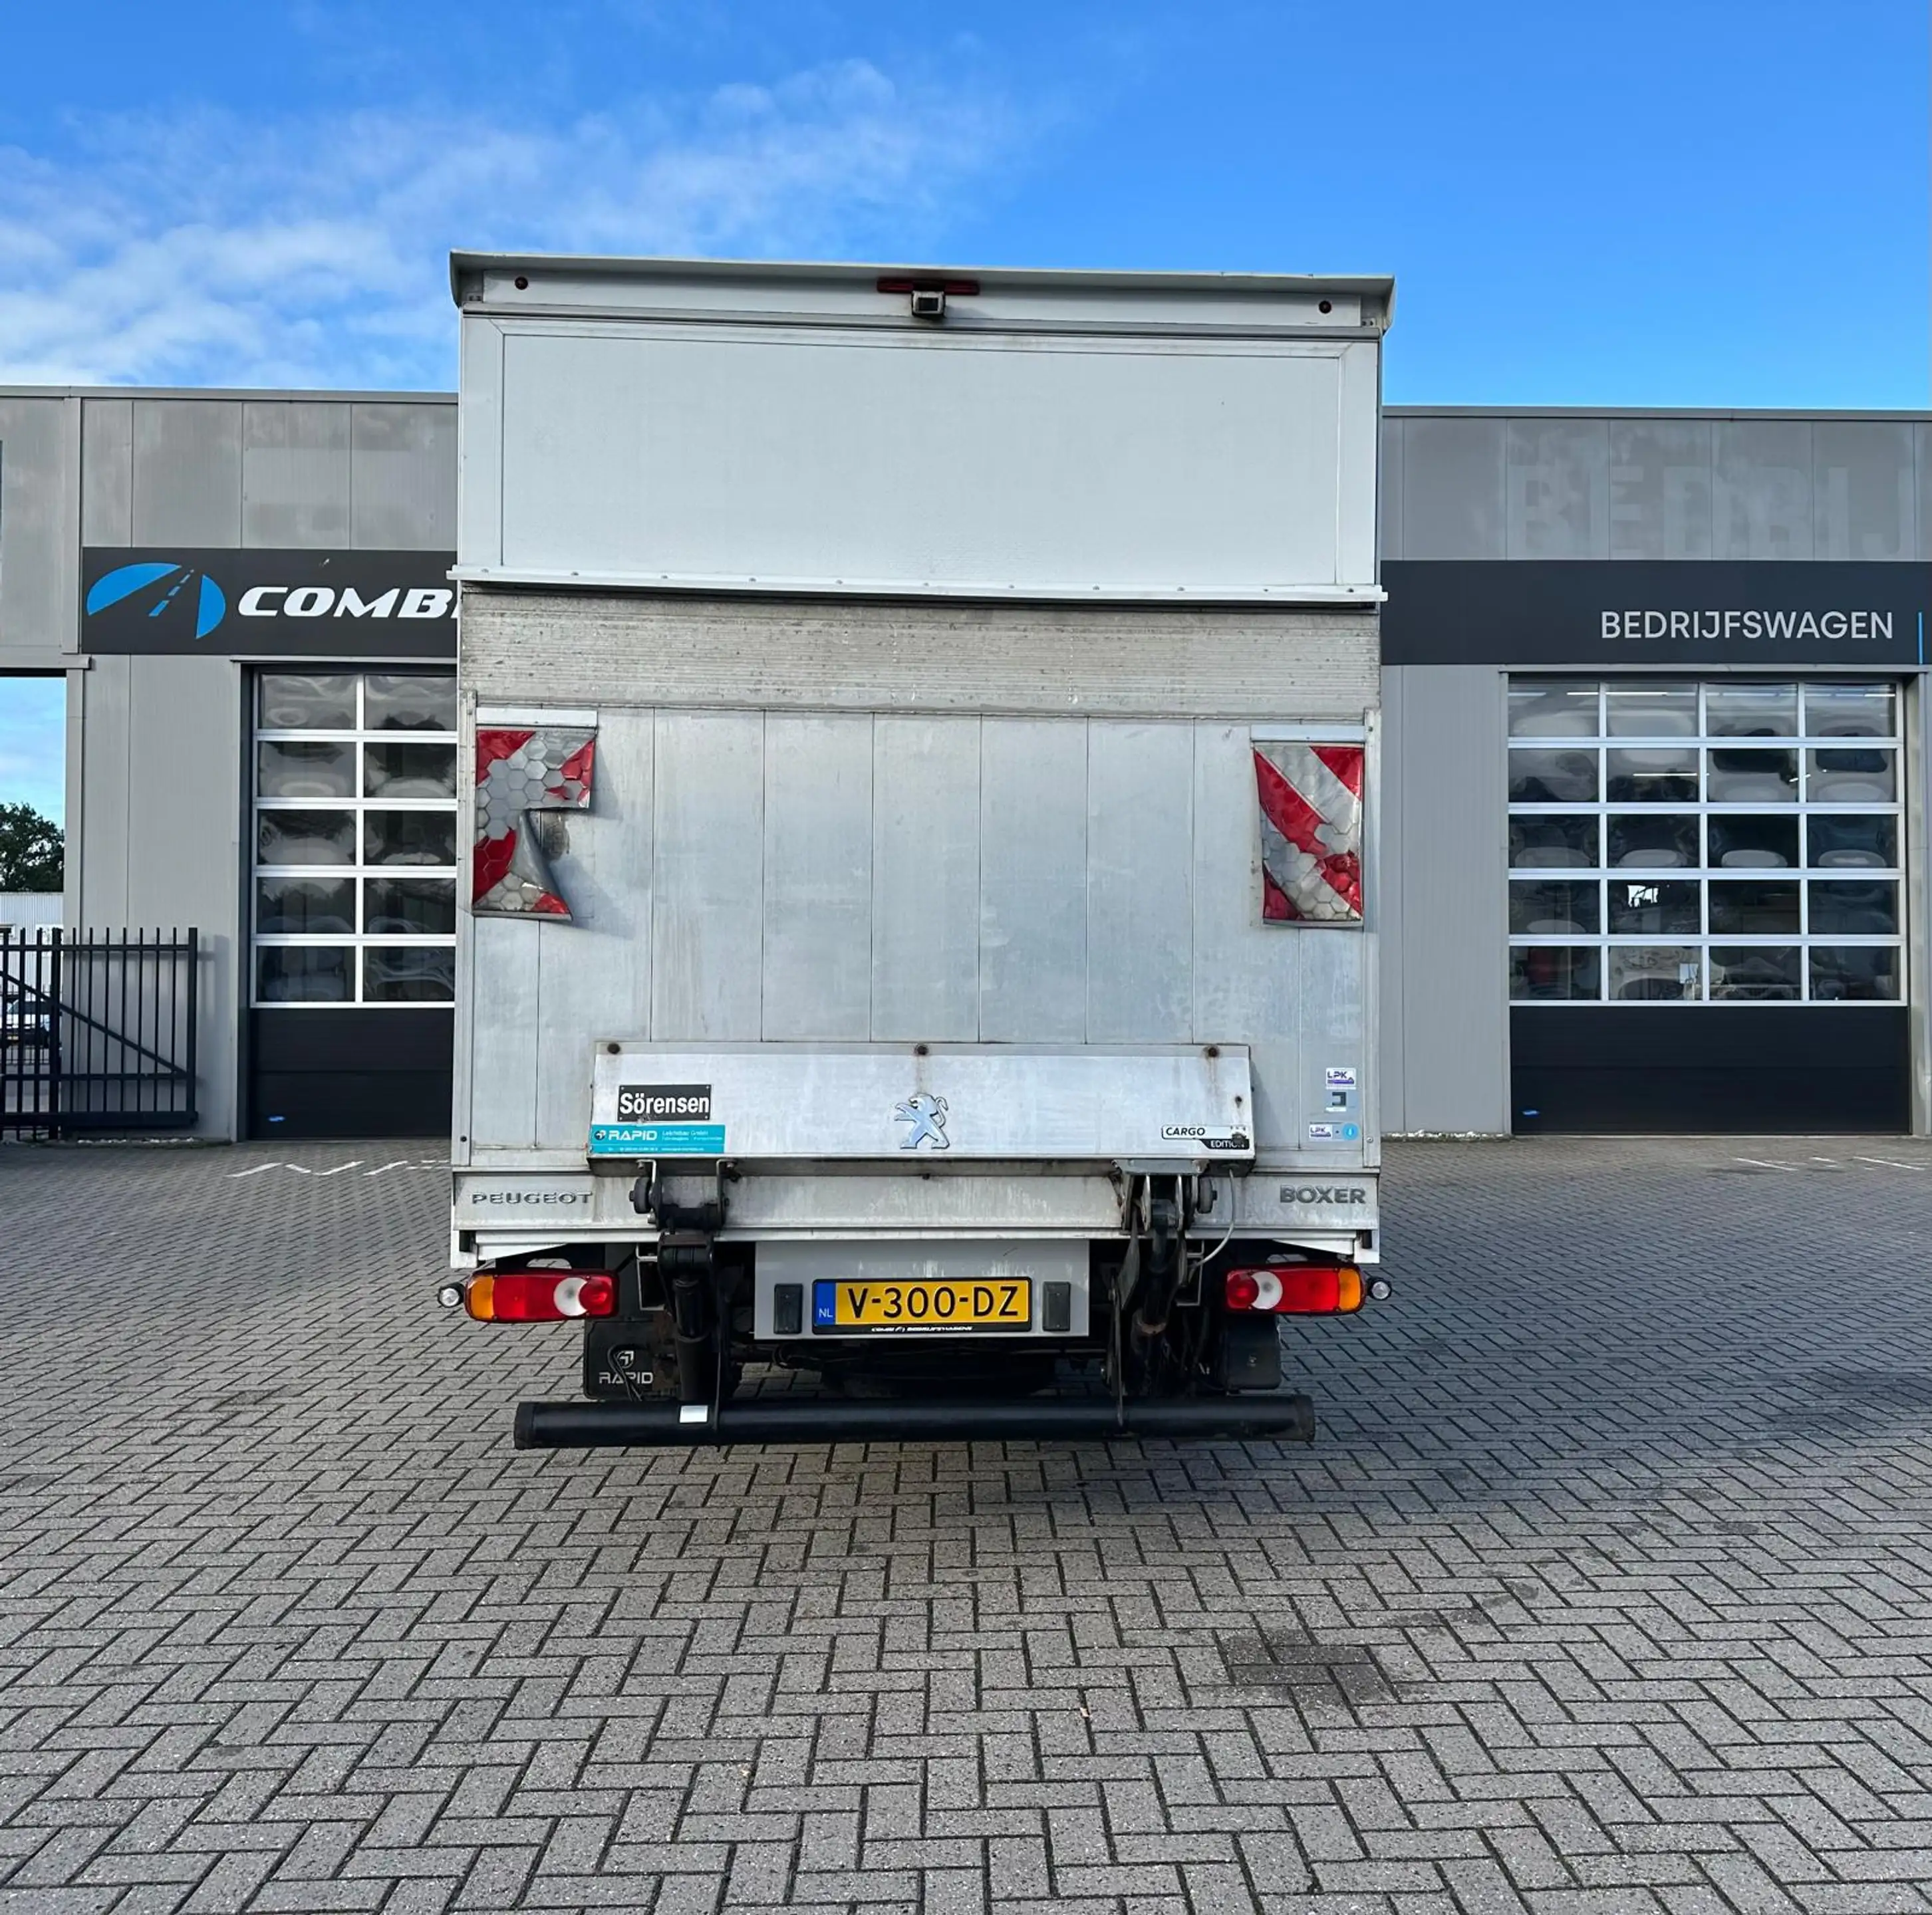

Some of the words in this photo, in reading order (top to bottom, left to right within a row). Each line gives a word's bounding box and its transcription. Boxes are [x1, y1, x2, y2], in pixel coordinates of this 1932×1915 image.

[1601, 610, 1893, 640] BEDRIJFSWAGEN
[619, 1092, 709, 1114] Sörensen
[609, 1130, 658, 1141] RAPID
[1166, 1127, 1206, 1136] CARGO
[472, 1192, 593, 1205] PEUGEOT
[1280, 1184, 1366, 1204] BOXER
[848, 1286, 1019, 1319] V-300-DZ
[818, 1307, 833, 1318] NL
